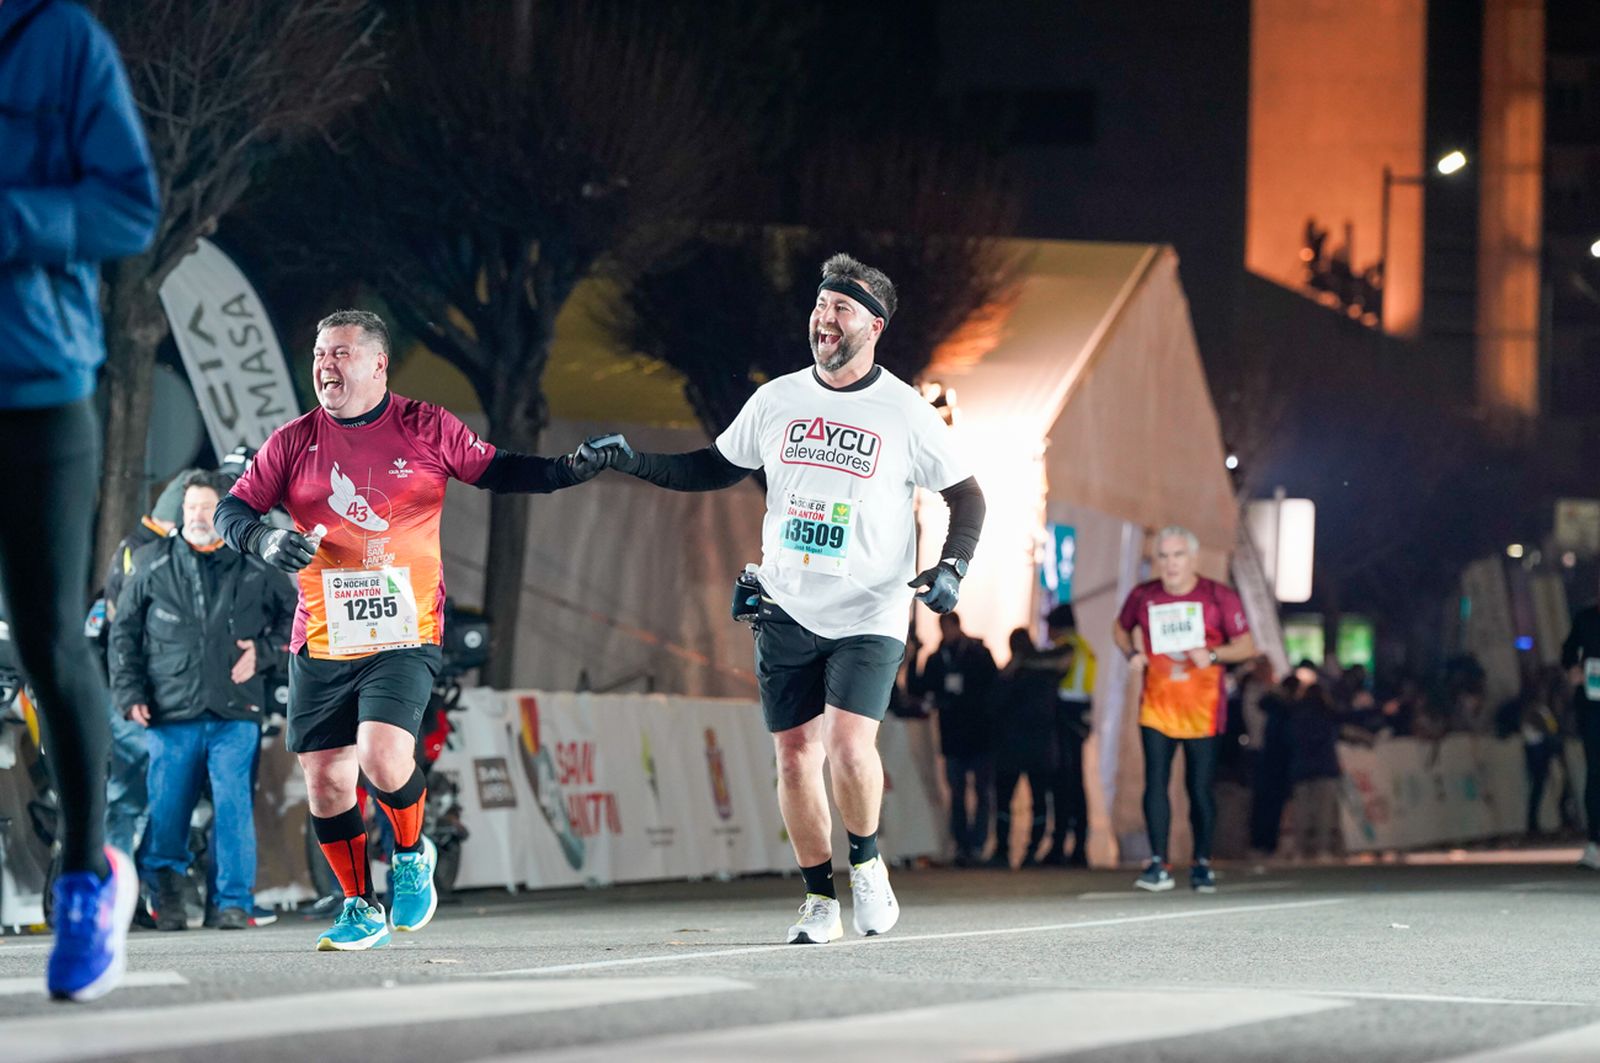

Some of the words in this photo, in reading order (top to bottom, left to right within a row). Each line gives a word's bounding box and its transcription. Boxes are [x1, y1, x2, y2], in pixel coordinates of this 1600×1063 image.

[789, 416, 876, 456] CAYCU
[785, 443, 871, 473] elevadores
[346, 502, 368, 522] 43
[798, 509, 826, 522] ANTÓN
[815, 502, 827, 512] DE
[785, 518, 844, 548] 13509
[334, 590, 352, 599] SAN
[353, 587, 381, 599] ANTÓN
[343, 579, 369, 589] NOCHE
[370, 578, 380, 587] DE
[343, 596, 398, 621] 1255
